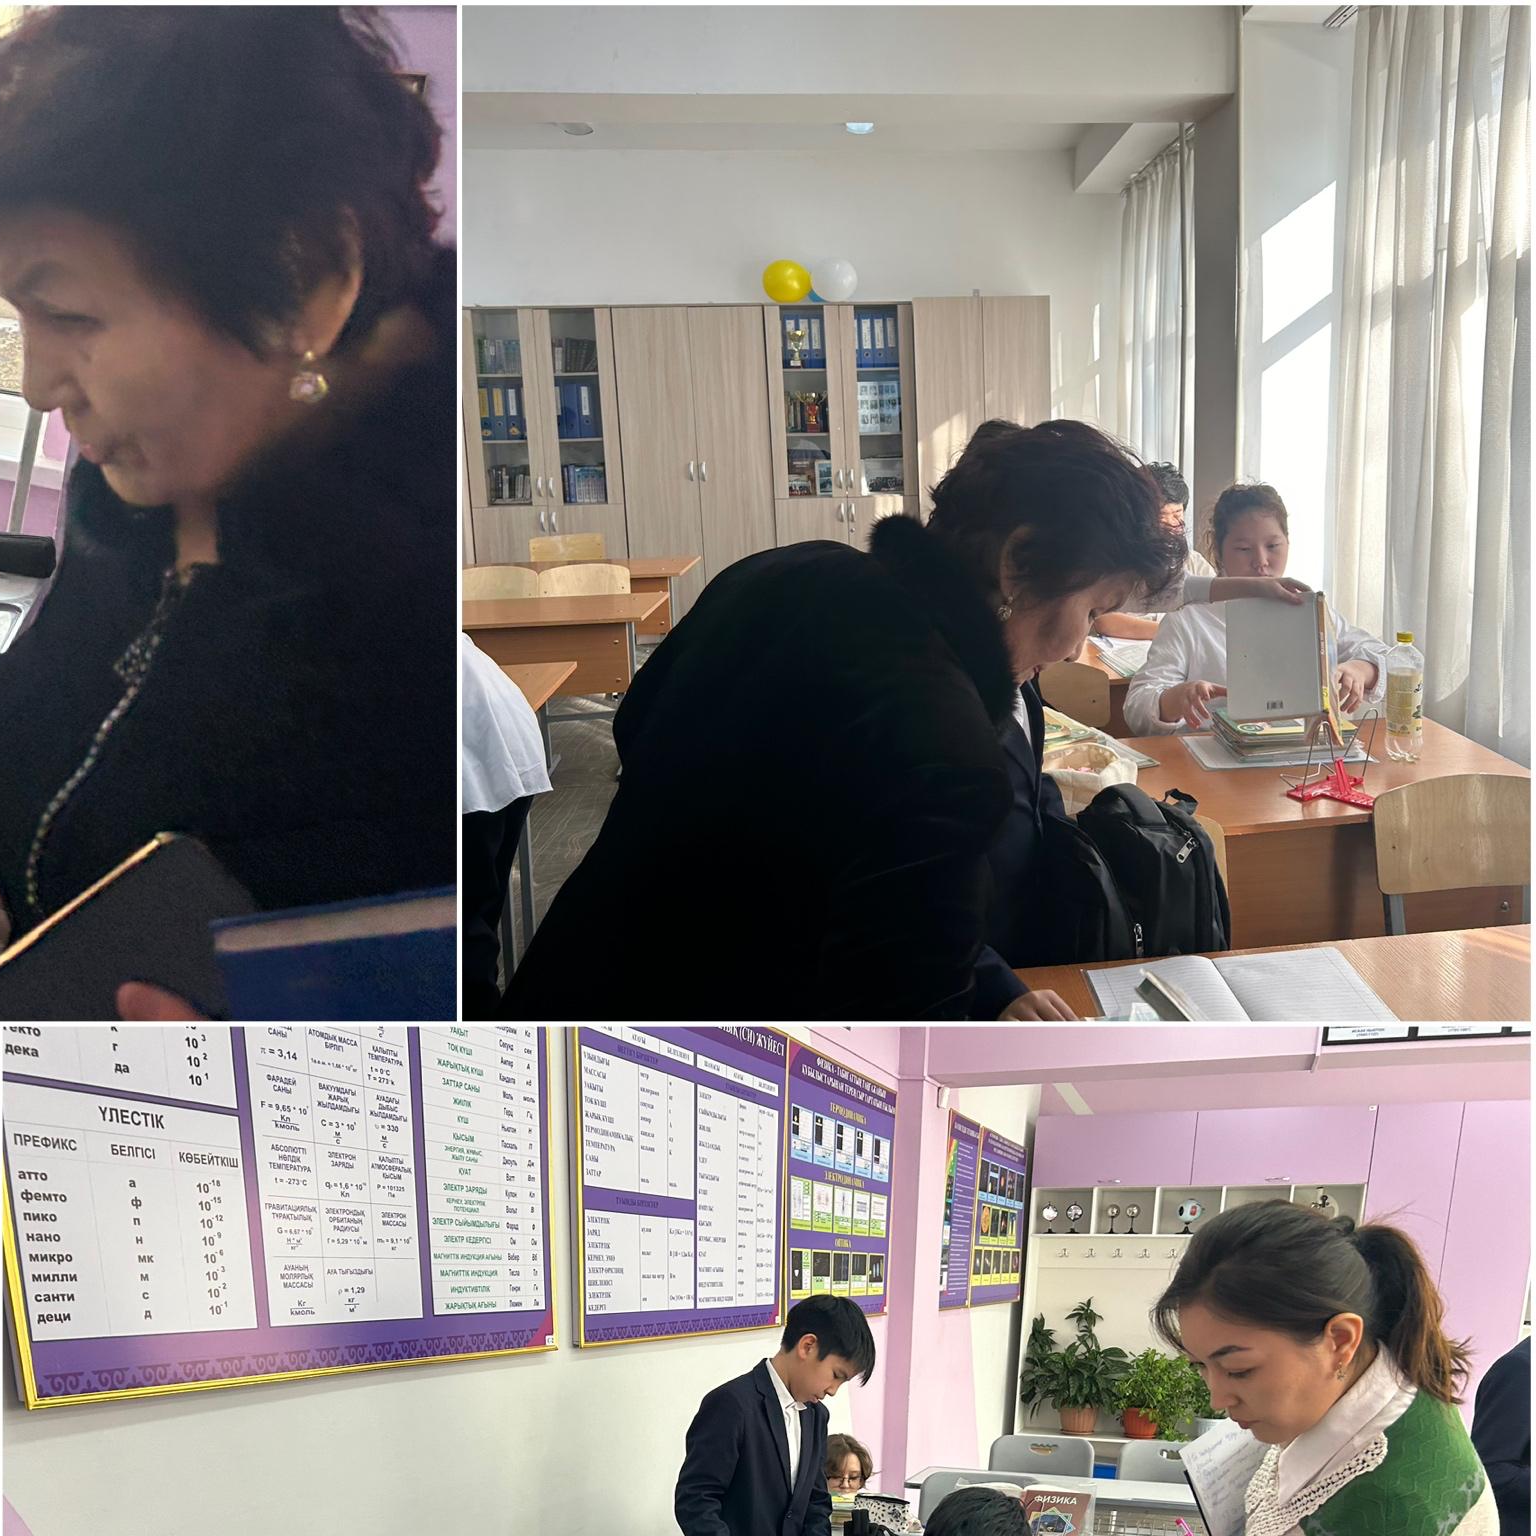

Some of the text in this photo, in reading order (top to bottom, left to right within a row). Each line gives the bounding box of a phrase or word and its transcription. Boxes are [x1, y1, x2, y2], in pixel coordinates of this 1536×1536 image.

[5, 1042, 40, 1058] дека
[98, 1105, 165, 1130] ҮЛЕСТІК
[13, 1132, 78, 1152] ПРЕФИКС
[110, 1143, 156, 1160] БЕЛГІСІ
[179, 1151, 239, 1168] КӨБЕЙТКІШ
[18, 1170, 48, 1181] атто
[20, 1189, 67, 1203] фемто
[23, 1210, 57, 1222] пико
[26, 1231, 61, 1243] нано
[28, 1252, 73, 1268] микро
[31, 1272, 78, 1283] милли
[34, 1291, 75, 1303] санти
[37, 1312, 71, 1324] деци
[1034, 1494, 1078, 1506] ФИЗИКА
